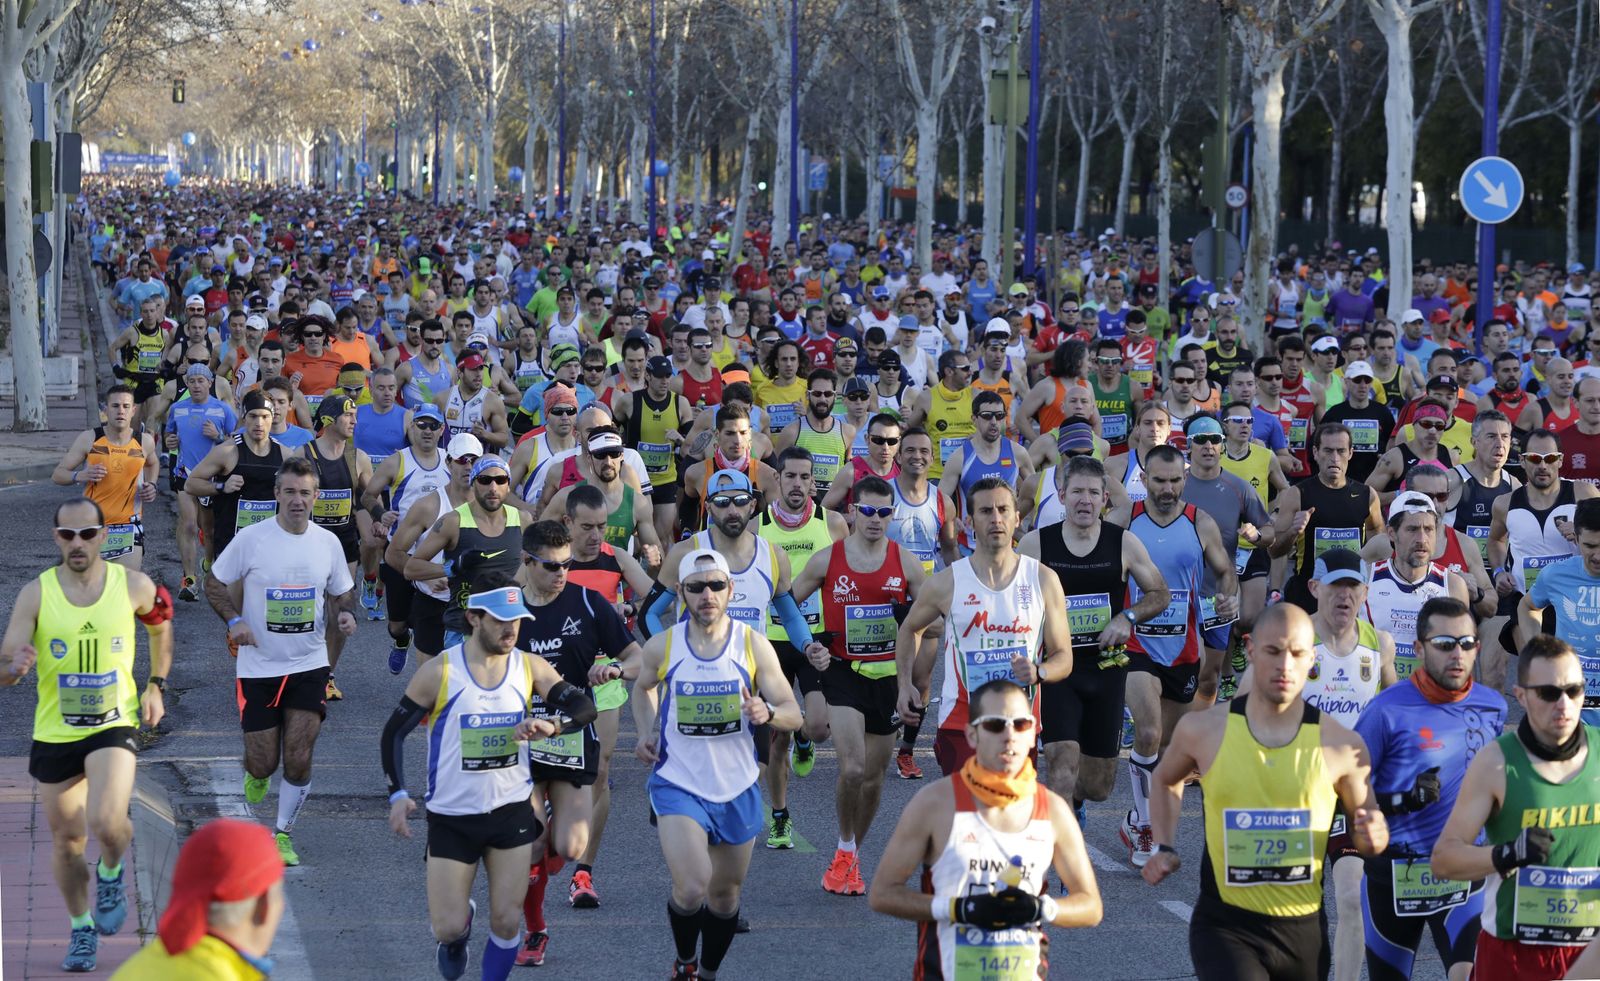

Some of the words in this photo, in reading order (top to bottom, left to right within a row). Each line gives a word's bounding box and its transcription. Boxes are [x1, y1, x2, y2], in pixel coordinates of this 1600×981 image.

[1229, 192, 1244, 201] 50
[814, 467, 829, 476] 558
[326, 491, 348, 499] ZURICH
[252, 503, 273, 511] ZURICH
[324, 503, 340, 512] 357
[251, 514, 267, 523] 982
[108, 537, 123, 546] 659
[284, 591, 311, 600] ZURICH
[833, 594, 860, 603] Sevilla
[1072, 598, 1103, 608] ZURICH
[282, 606, 303, 616] 809
[724, 609, 754, 618] ZURICH
[866, 606, 893, 617] ZURICH
[1070, 612, 1099, 626] 1176
[865, 623, 885, 635] 782
[79, 674, 113, 686] ZURICH
[985, 669, 1016, 682] 1626
[696, 683, 732, 694] ZURICH
[80, 694, 104, 706] 684
[696, 702, 722, 715] 926
[481, 715, 517, 726] ZURICH
[482, 734, 507, 748] 865
[544, 737, 565, 748] 960
[1254, 815, 1301, 826] ZURICH
[1253, 839, 1287, 855] 729
[1548, 874, 1594, 886] ZURICH
[1402, 888, 1438, 897] MANUEL
[1546, 898, 1579, 914] 562
[1548, 916, 1574, 924] TONY
[979, 956, 1021, 972] 1447
